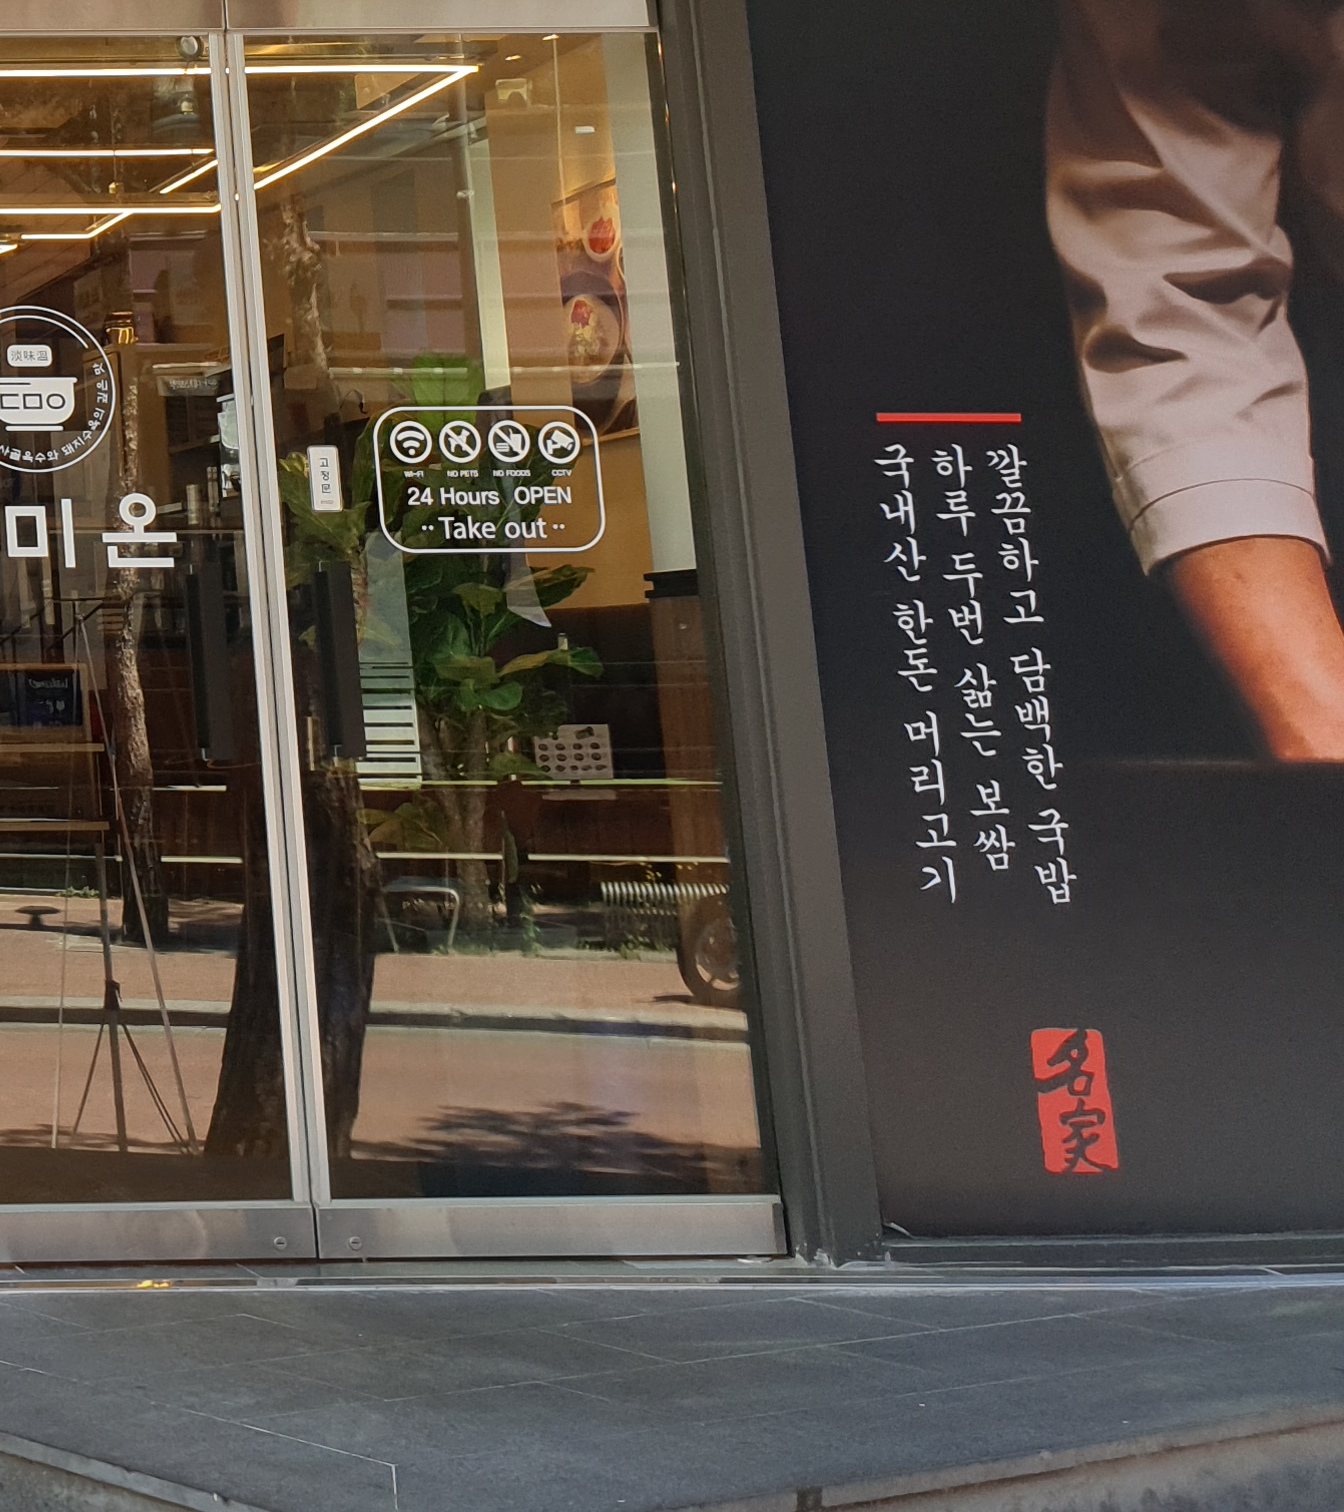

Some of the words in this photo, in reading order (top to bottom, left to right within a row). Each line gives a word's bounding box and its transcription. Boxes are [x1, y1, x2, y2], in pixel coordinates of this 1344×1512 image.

[319, 457, 332, 494] 고정문
[407, 487, 434, 506] 24
[440, 488, 501, 506] Hours
[513, 486, 572, 506] OPEN
[446, 469, 459, 478] NO
[459, 469, 479, 478] PETS
[492, 469, 505, 478] NO
[505, 469, 531, 478] FOODS
[551, 469, 572, 478] CCTV
[873, 443, 927, 583] 국내산
[930, 443, 976, 537] 하루
[438, 516, 496, 540] Take
[504, 517, 548, 539] out
[986, 443, 1045, 625] 깔끔하고
[892, 598, 939, 693] 한돈
[942, 551, 985, 646] 두번
[954, 662, 1002, 757] 삶는
[1010, 646, 1064, 791] 담백한
[903, 709, 958, 905] 머리고기
[970, 779, 1015, 872] 보쌈
[1028, 807, 1078, 905] 국밥
